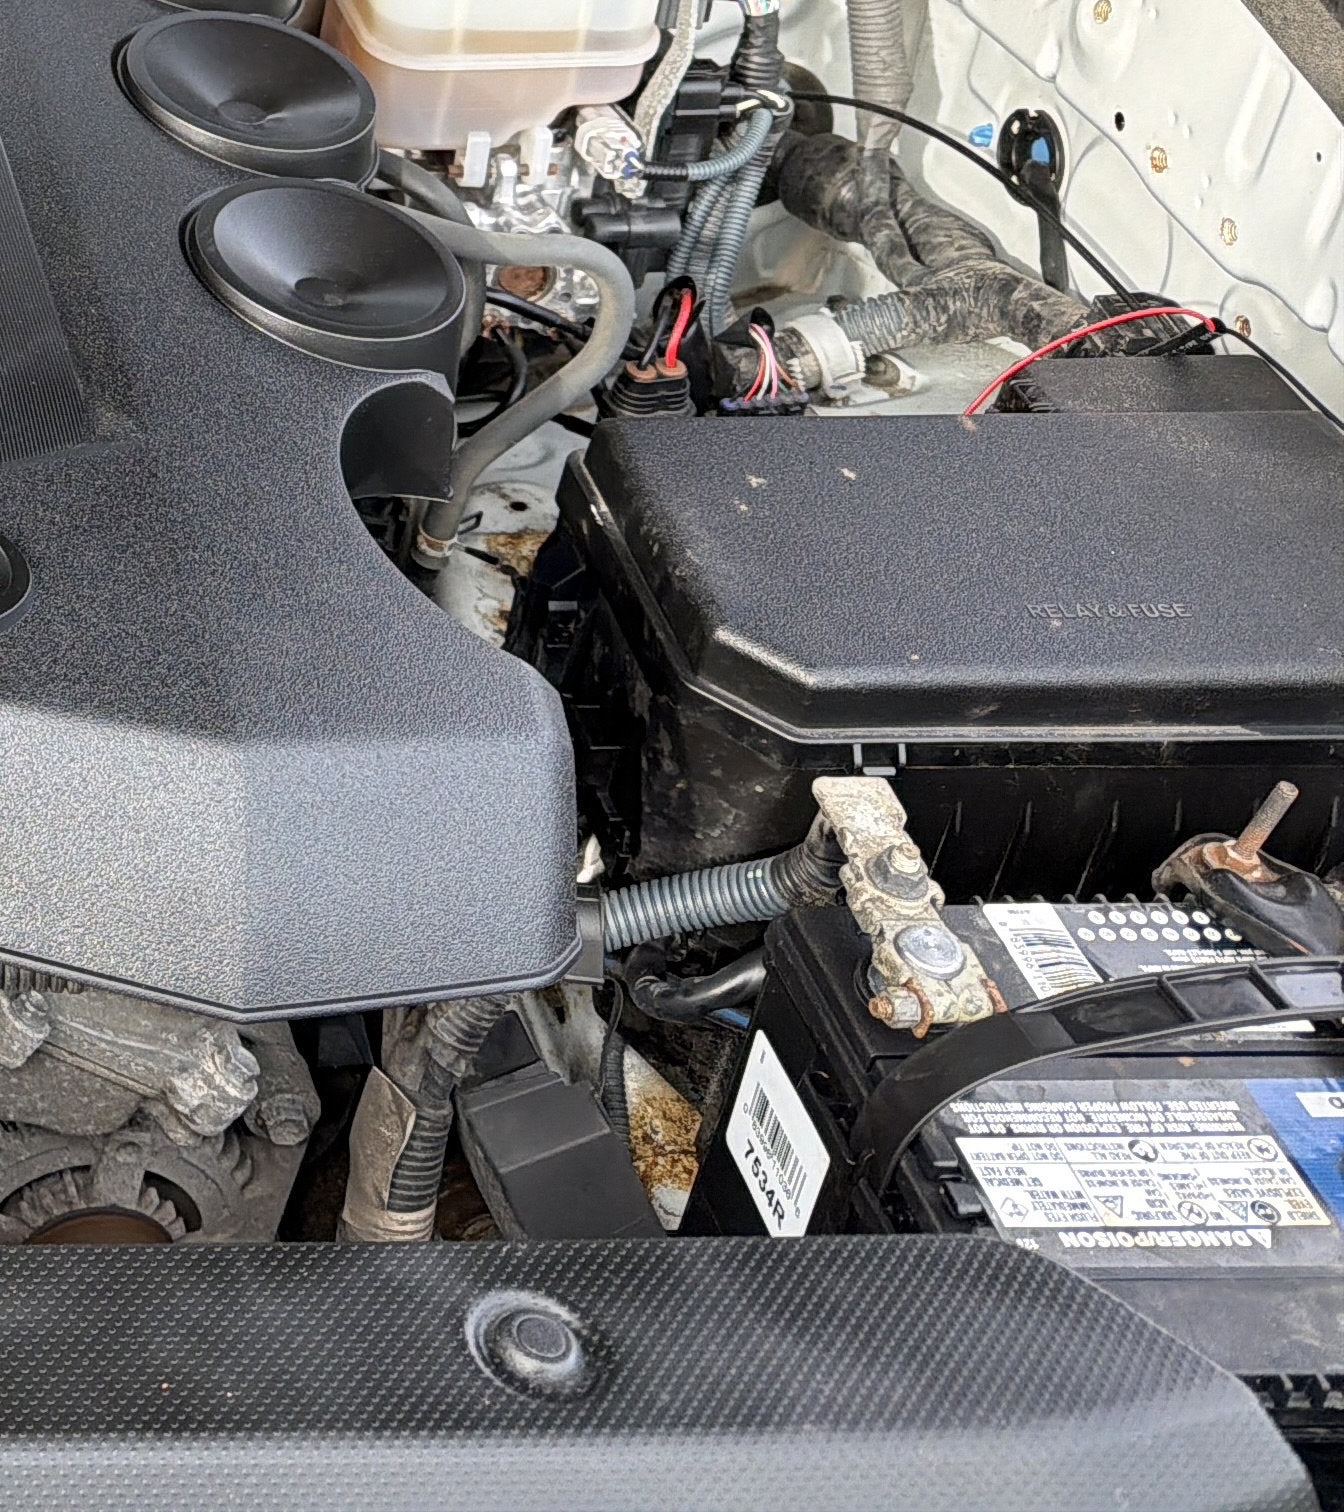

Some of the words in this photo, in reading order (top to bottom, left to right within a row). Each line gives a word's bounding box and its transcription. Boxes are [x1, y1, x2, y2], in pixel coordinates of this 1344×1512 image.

[1025, 602, 1103, 619] RELAY
[1106, 603, 1124, 619] &
[1125, 602, 1193, 619] FUSE
[743, 1137, 786, 1231] 7534R
[1057, 1230, 1254, 1248] DANGER/POISON
